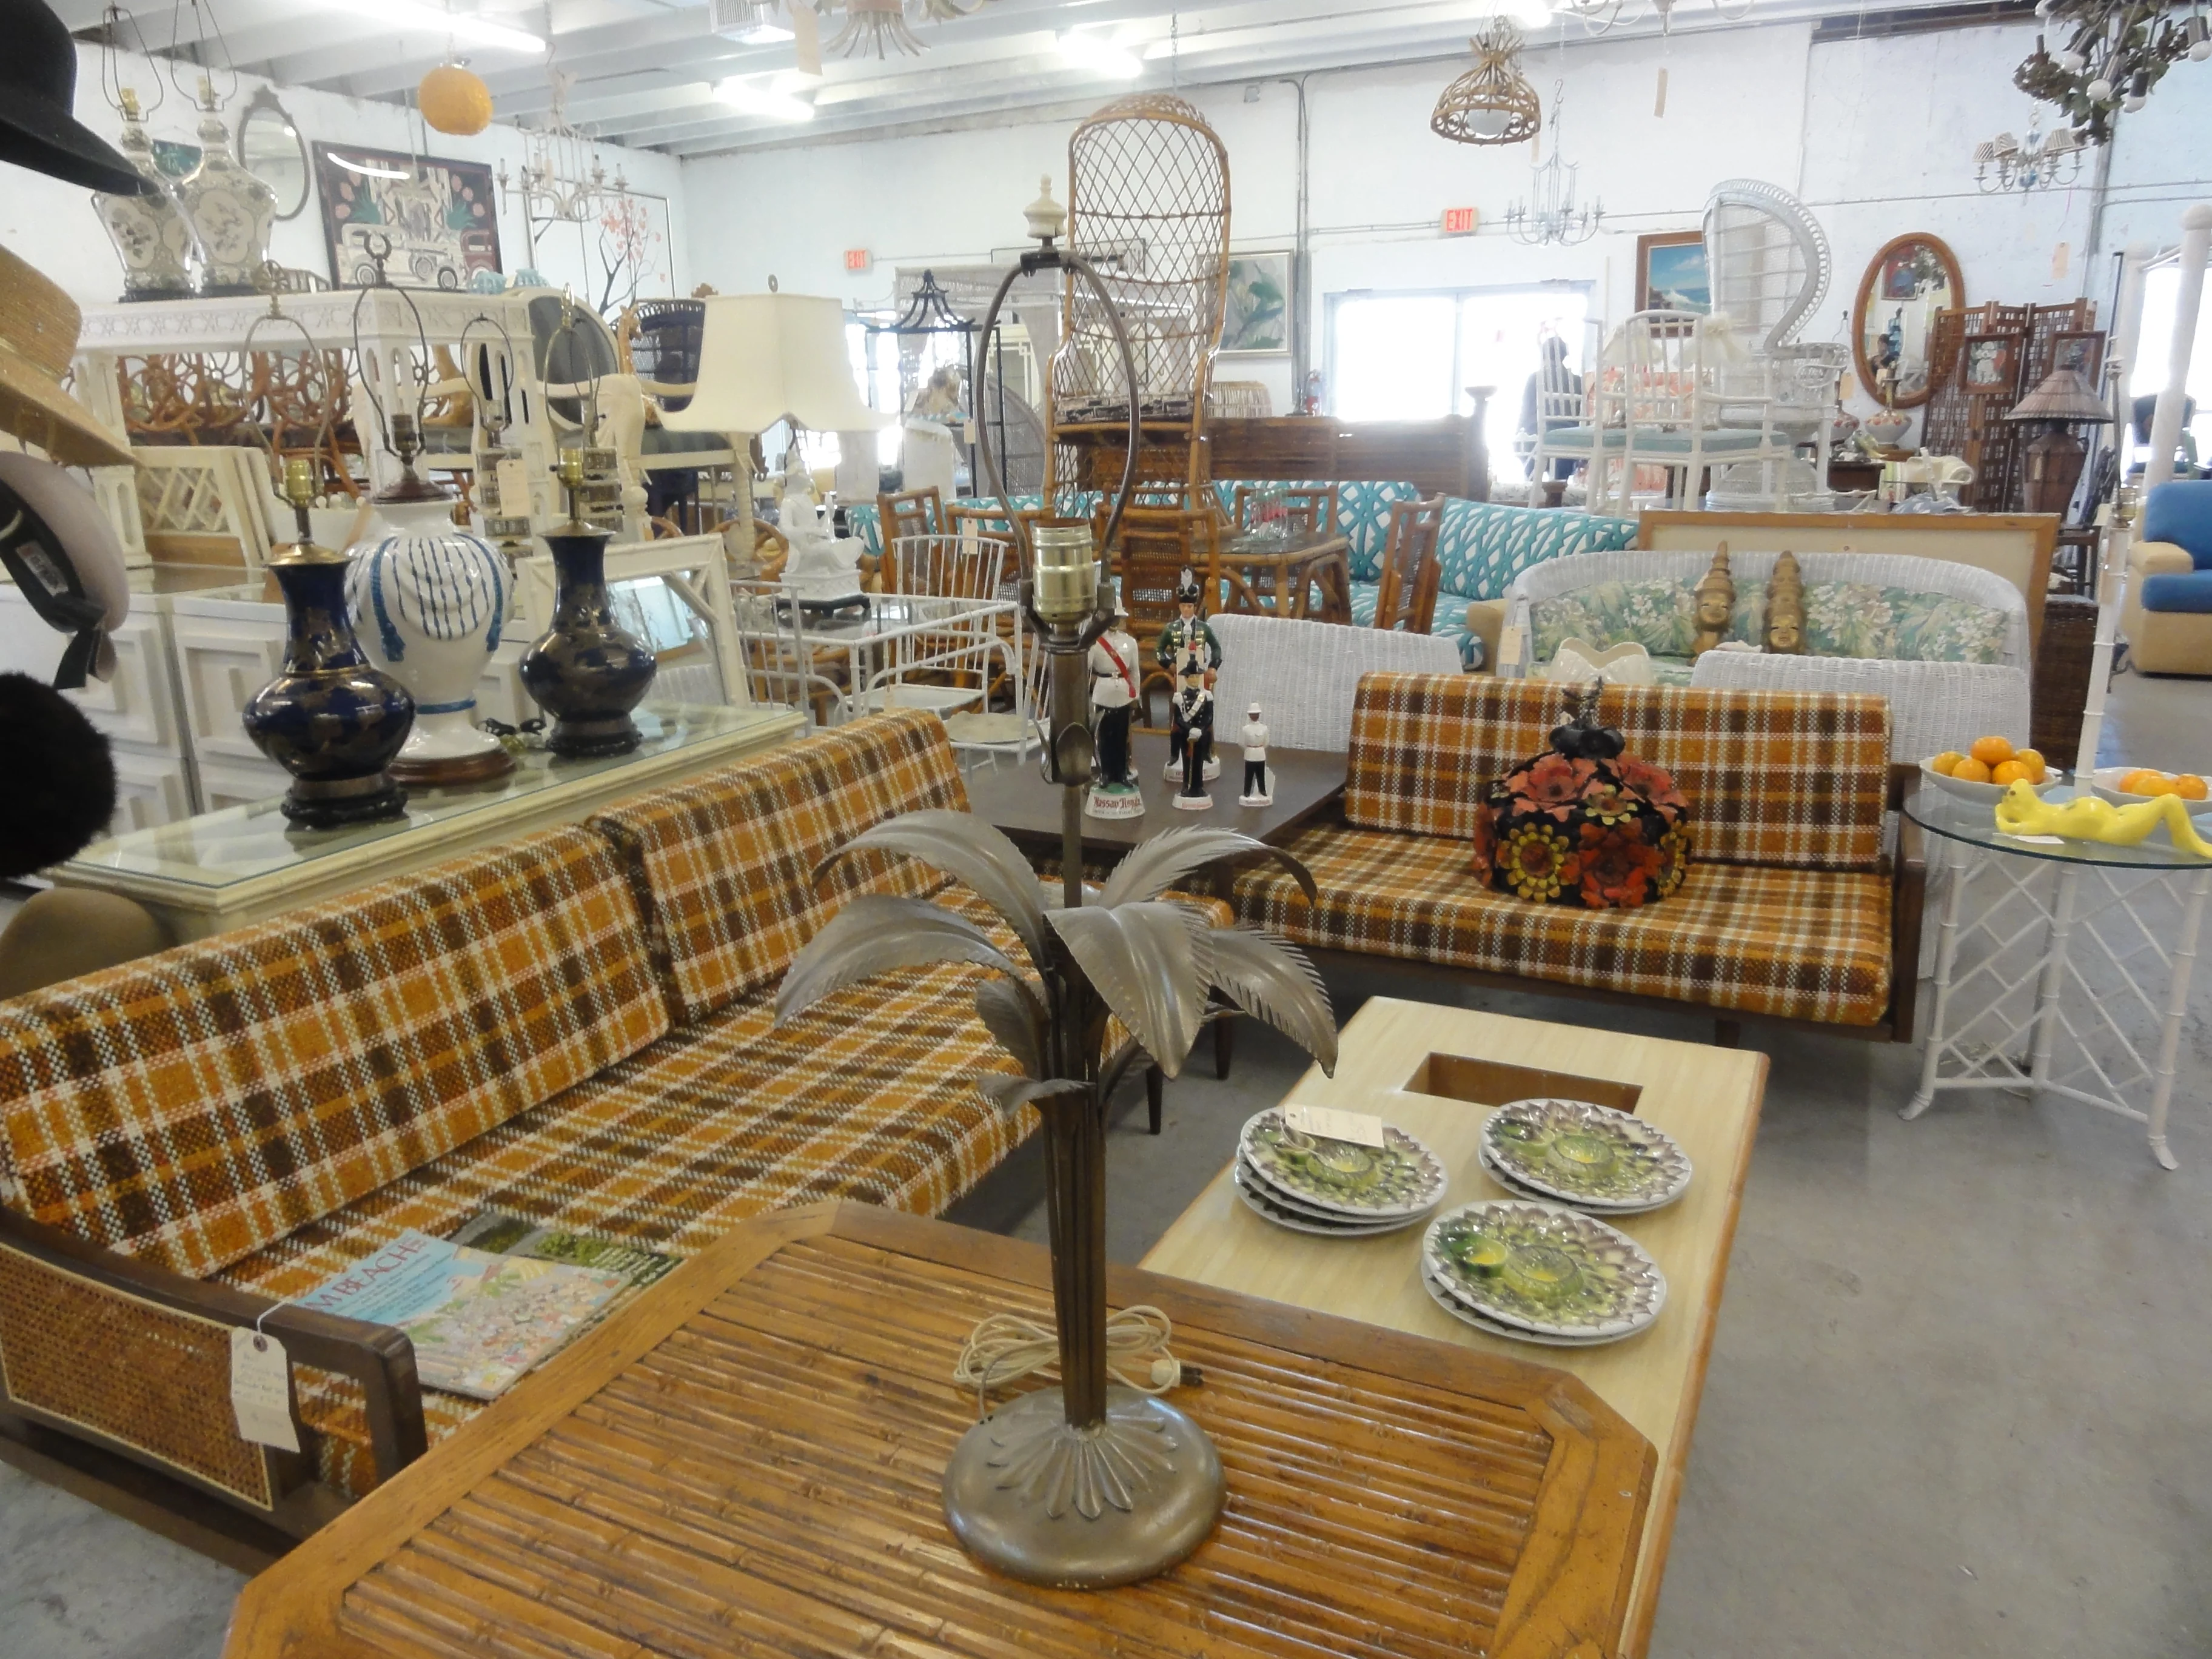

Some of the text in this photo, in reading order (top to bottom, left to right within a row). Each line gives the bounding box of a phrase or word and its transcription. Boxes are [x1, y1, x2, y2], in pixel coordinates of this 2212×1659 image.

[1447, 208, 1473, 231] EXIT
[847, 250, 865, 269] EXIT
[332, 1244, 418, 1296] BEACH
